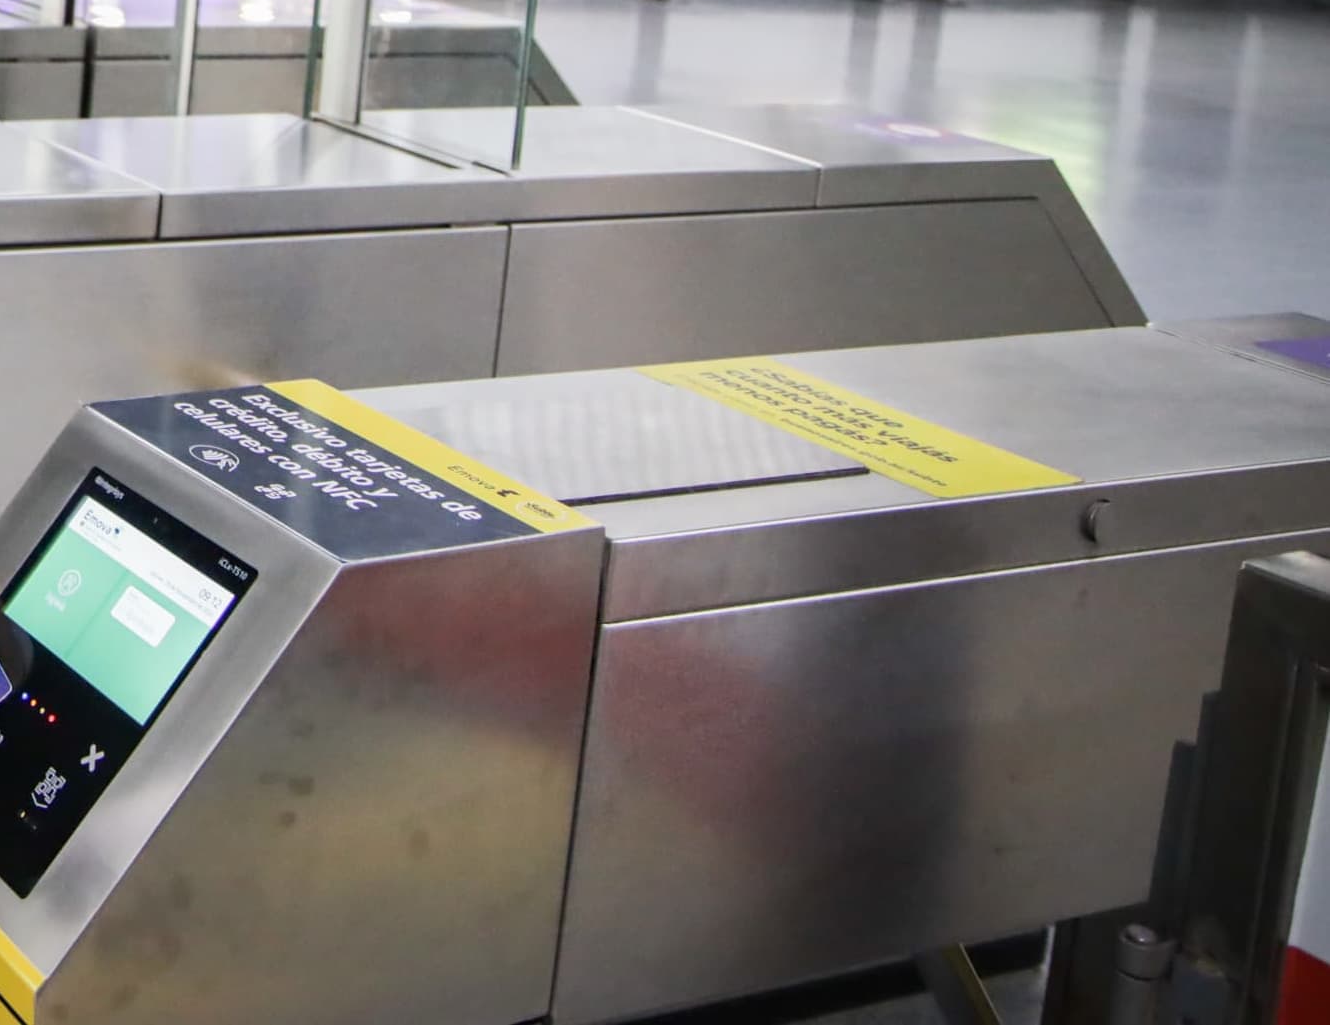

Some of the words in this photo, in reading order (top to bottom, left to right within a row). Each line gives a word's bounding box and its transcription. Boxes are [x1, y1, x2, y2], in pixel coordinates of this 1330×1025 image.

[699, 372, 785, 406] menos
[850, 408, 904, 428] que
[173, 402, 272, 454] celulares
[268, 454, 317, 479] con
[312, 480, 379, 511] NFC
[208, 398, 288, 443] crédito,
[291, 444, 374, 487] débito
[363, 487, 399, 498] y
[241, 394, 347, 448] Exclusivo
[345, 448, 445, 500] tarjetas
[441, 501, 482, 521] de
[877, 430, 959, 463] viajás
[446, 465, 496, 490] Emova
